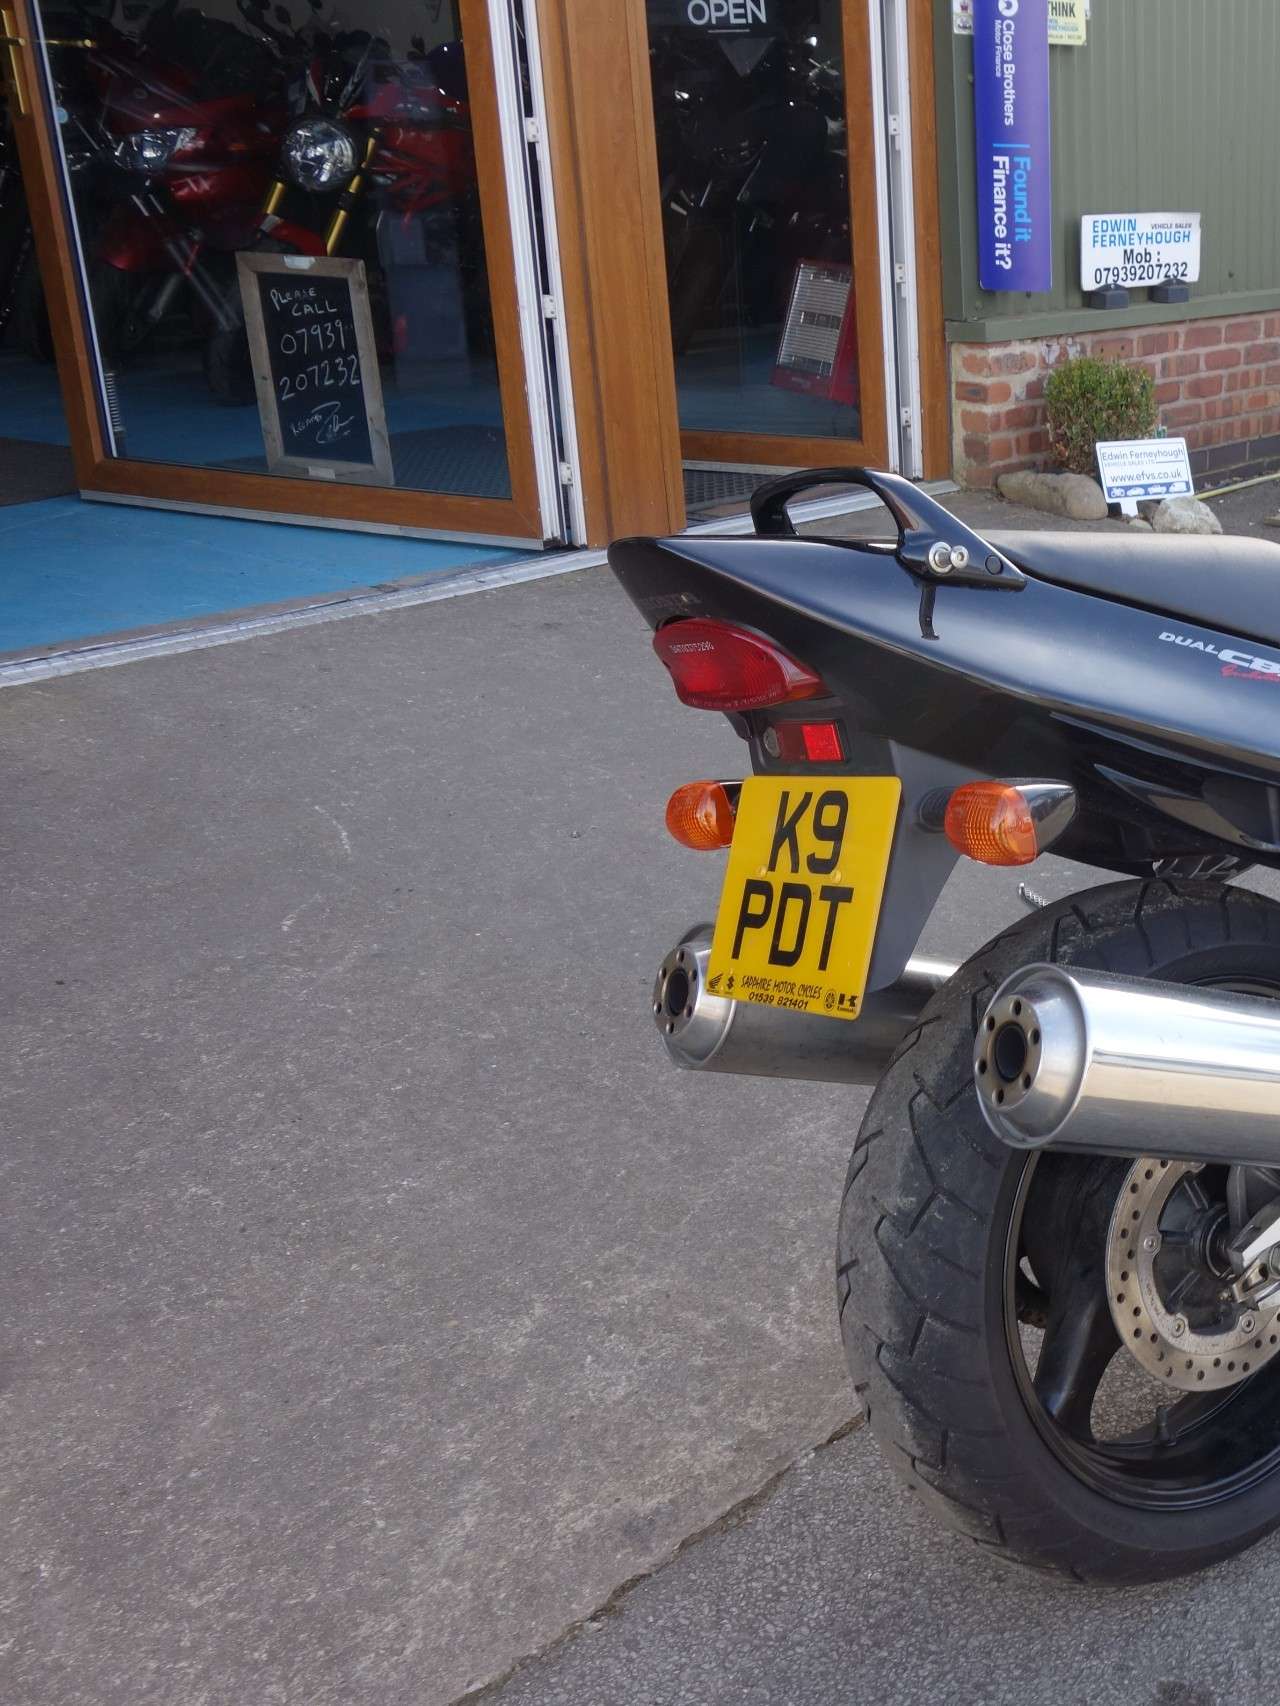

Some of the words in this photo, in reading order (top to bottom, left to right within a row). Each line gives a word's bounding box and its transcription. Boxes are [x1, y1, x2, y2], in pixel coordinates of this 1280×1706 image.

[687, 0, 767, 25] OPEN
[994, 19, 1002, 45] Motor
[1003, 19, 1015, 61] Close
[1004, 63, 1016, 126] Brothers
[993, 155, 1010, 238] Finance
[1014, 156, 1032, 223] Found
[1014, 227, 1032, 241] it
[1092, 218, 1137, 233] EDWIN
[1092, 230, 1192, 248] FERNEYHOUGH
[995, 242, 1012, 270] it?
[1123, 247, 1153, 265] Mob
[1093, 261, 1188, 285] 07939207232
[270, 287, 318, 311] PLEASE
[291, 300, 338, 317] CALL
[280, 318, 346, 355] 07939
[279, 354, 361, 401] 207232
[1101, 452, 1128, 461] Edwin
[1129, 447, 1185, 459] Ferneyhough
[1110, 468, 1182, 483] www.efvs.co.uk
[1158, 631, 1219, 655] DUAL
[767, 789, 849, 875] K9
[731, 878, 855, 972] PDT
[740, 975, 772, 992] SAPPHIRE
[773, 980, 797, 995] MOTOR
[799, 983, 823, 1000] CYCLES
[748, 991, 775, 1005] 01539
[776, 995, 809, 1010] 821401
